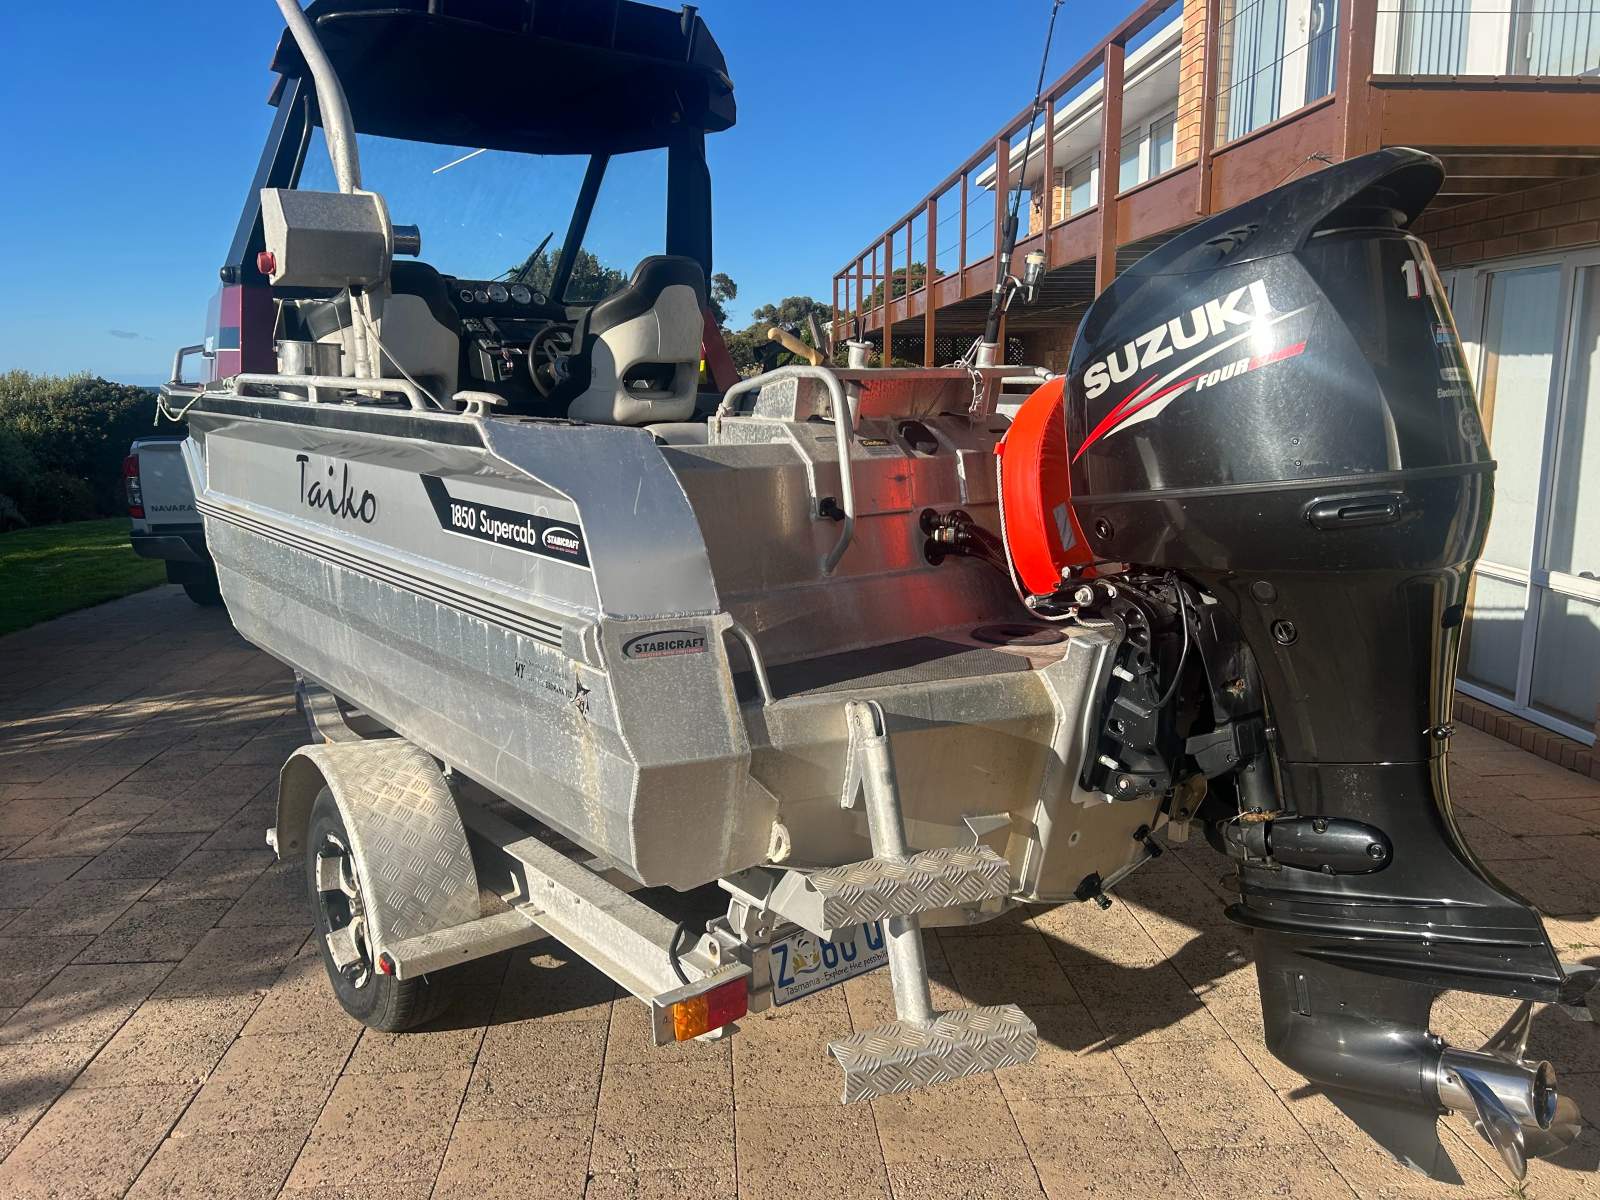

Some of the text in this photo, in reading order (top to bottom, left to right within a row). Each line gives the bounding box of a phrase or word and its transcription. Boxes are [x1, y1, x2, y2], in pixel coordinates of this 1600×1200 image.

[1083, 279, 1273, 400] SUZUKI
[1195, 358, 1250, 393] FOUR
[151, 504, 194, 513] NAVARA
[296, 454, 377, 524] Taiko
[450, 503, 536, 546] 1850 Supercab
[546, 534, 580, 550] STABICRAFT
[634, 637, 705, 654] STABICRAFT
[771, 943, 795, 989] Z
